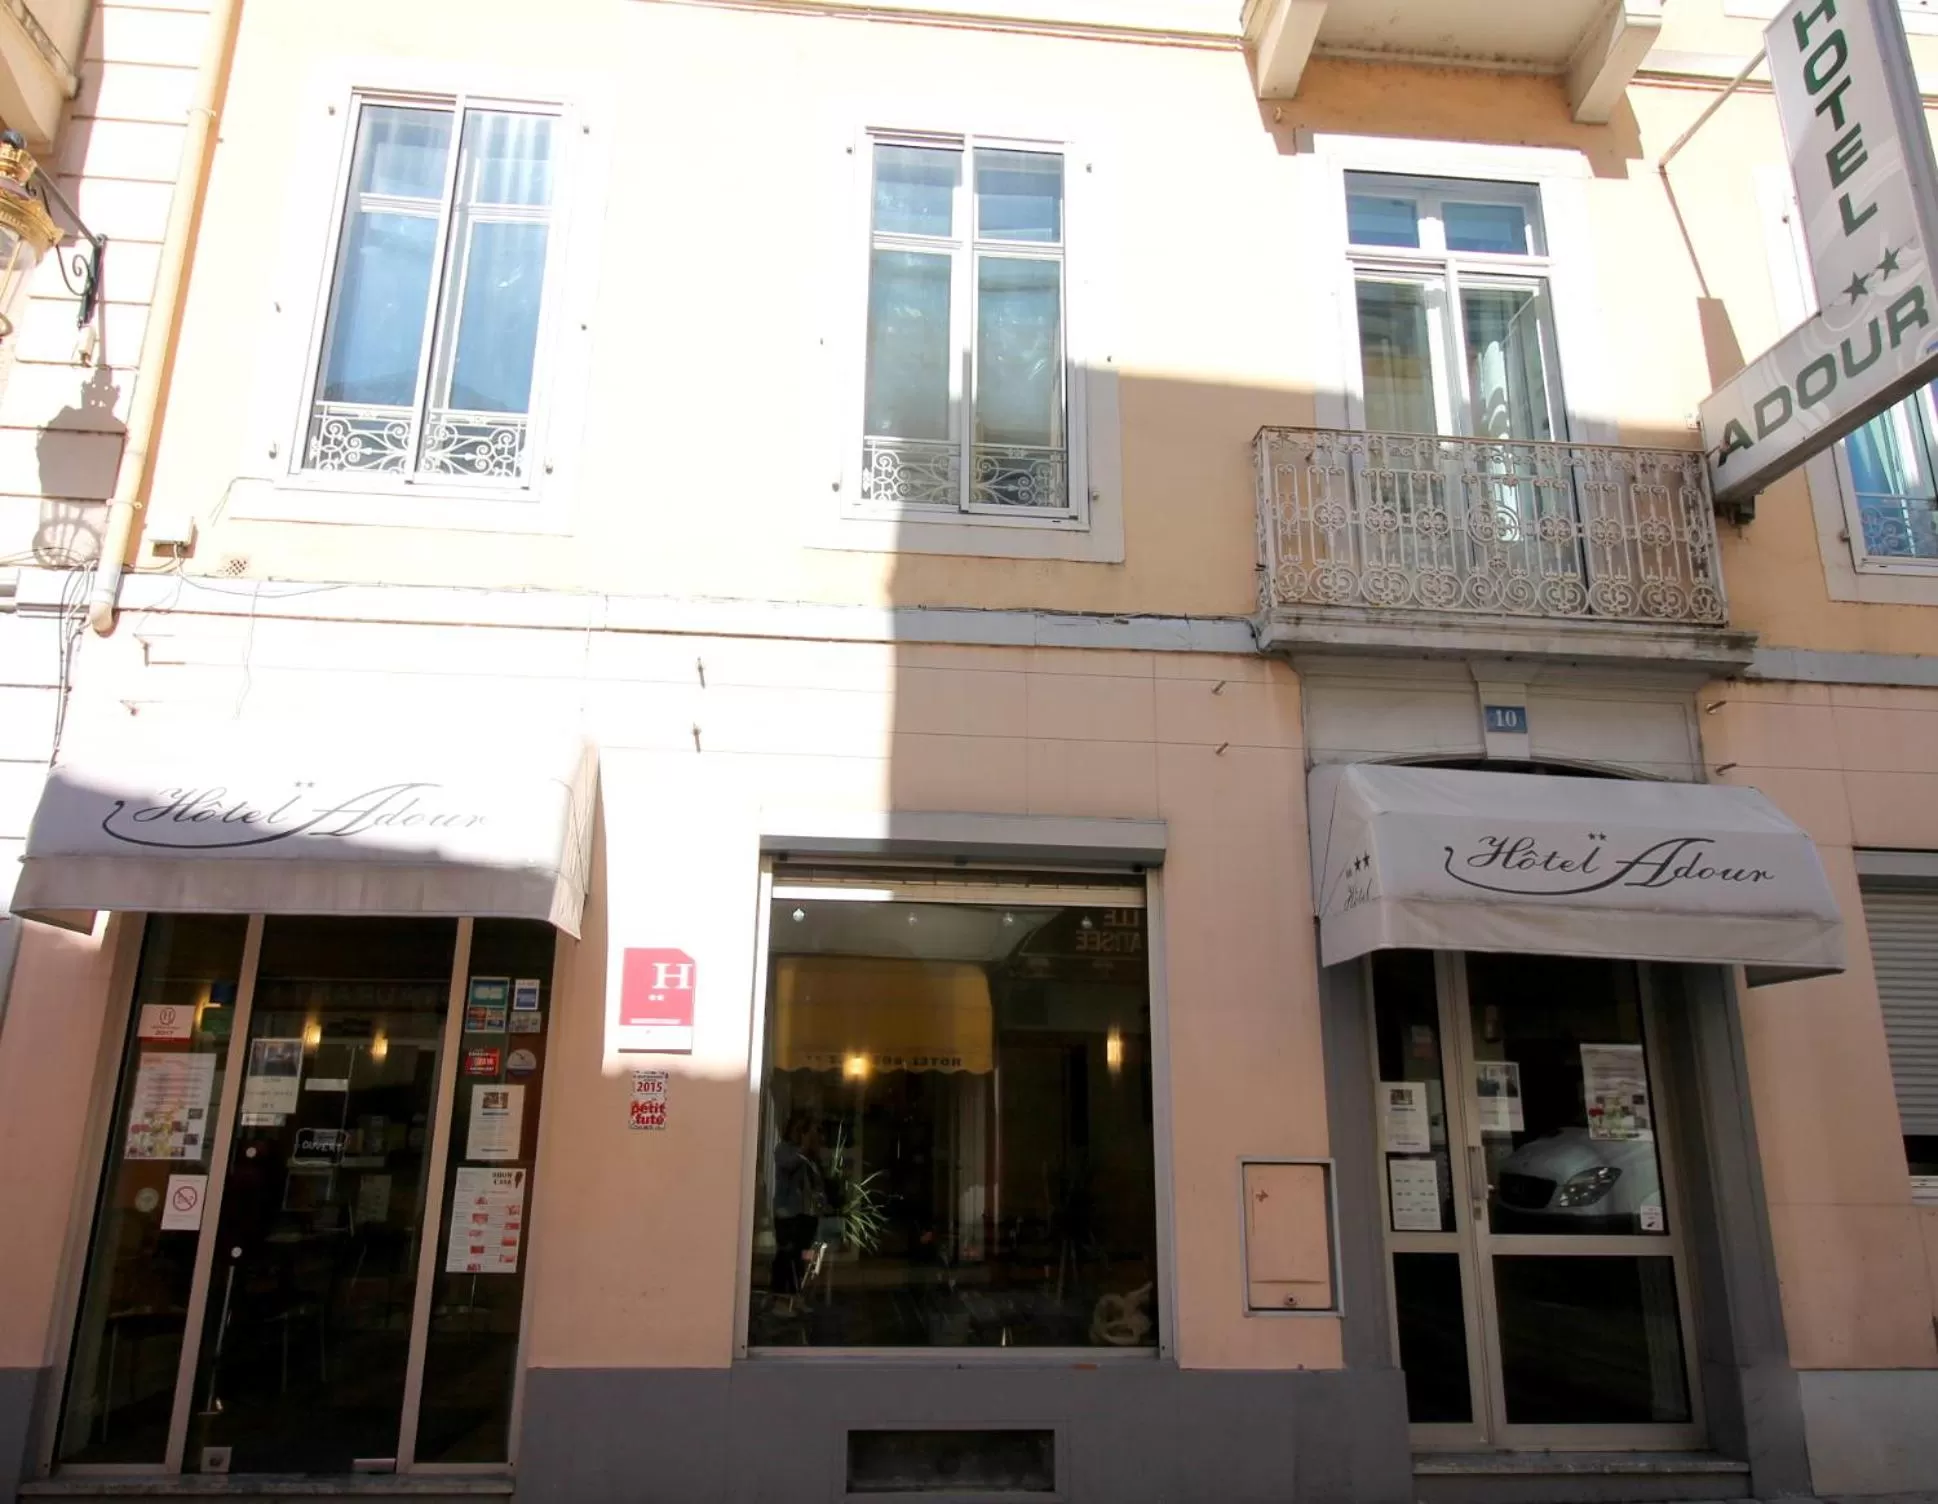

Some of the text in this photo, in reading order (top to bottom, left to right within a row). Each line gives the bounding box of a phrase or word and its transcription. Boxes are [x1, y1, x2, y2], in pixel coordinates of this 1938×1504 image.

[1792, 0, 1878, 237] HOTEL
[1717, 283, 1930, 468] ADOUR
[1495, 709, 1518, 727] 10
[132, 783, 488, 840] Hôtel Adour
[1467, 835, 1775, 888] Hôtel Adour
[652, 962, 693, 990] H
[637, 1081, 662, 1092] 2015
[302, 1140, 342, 1153] OUVERT
